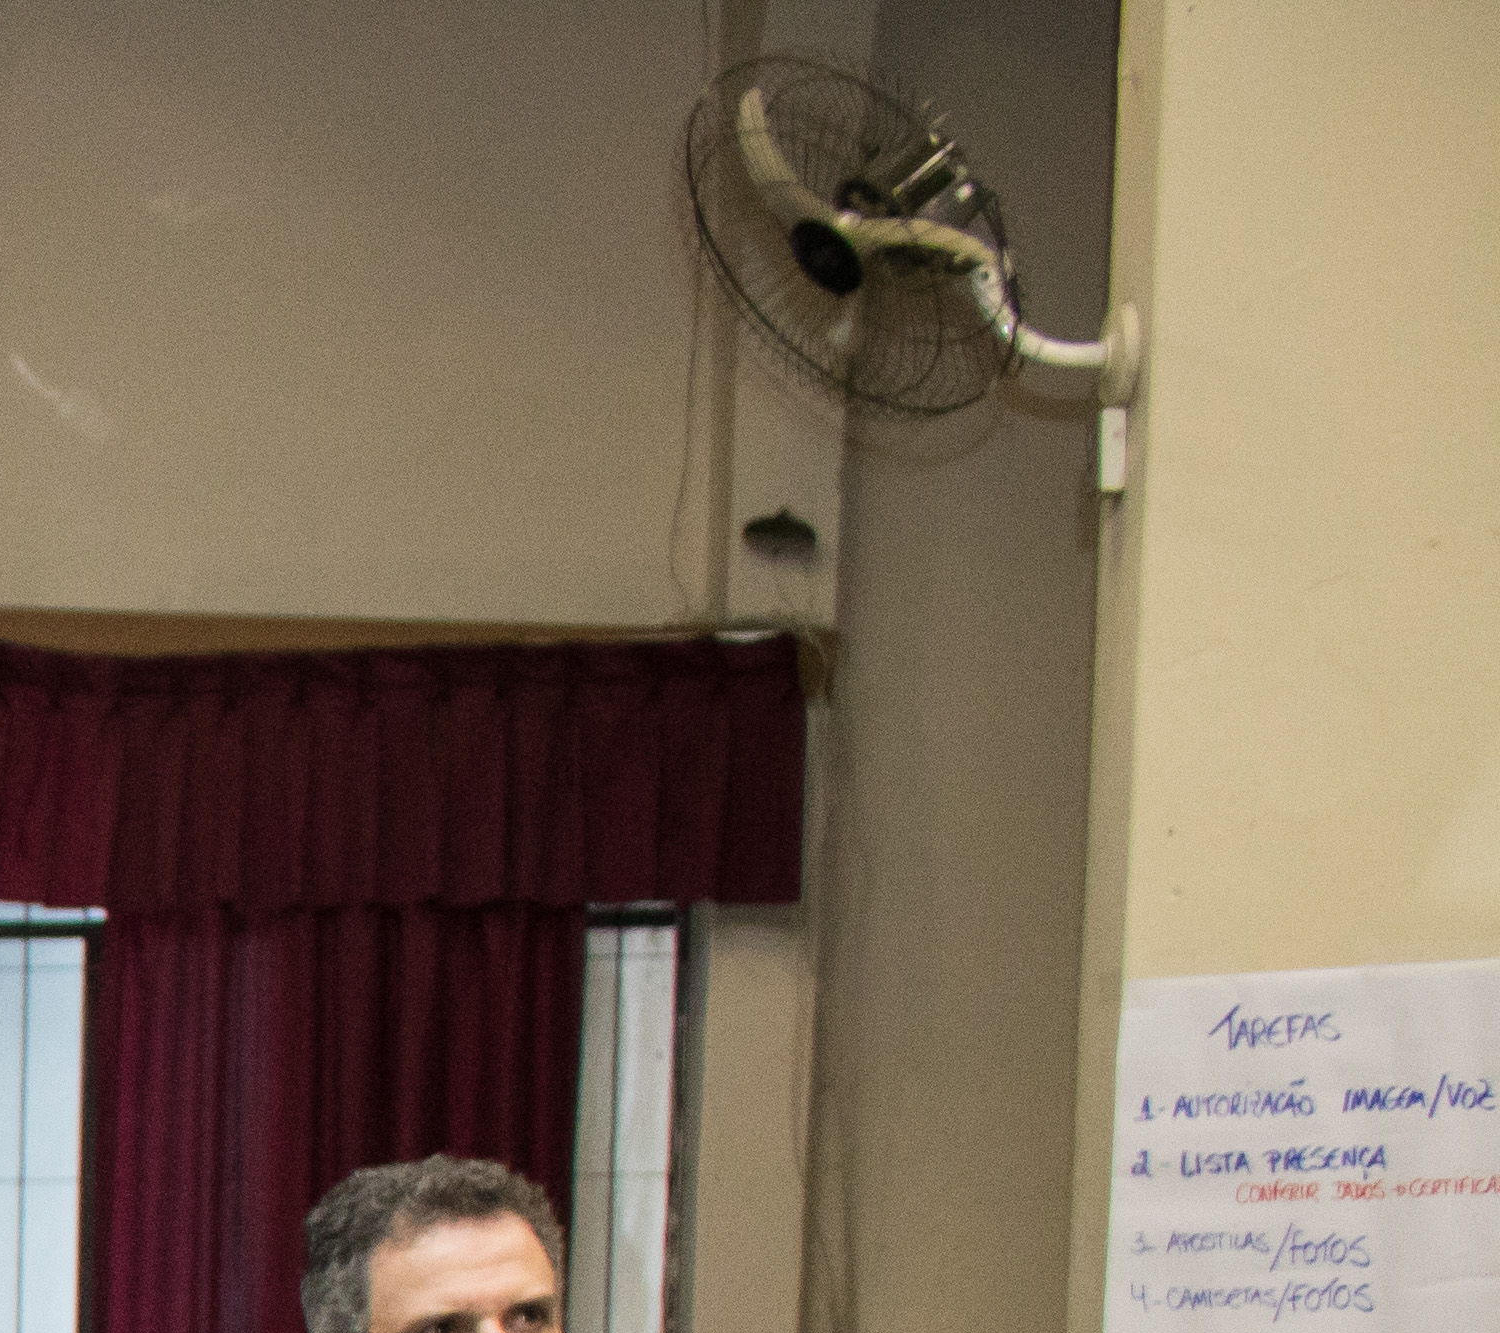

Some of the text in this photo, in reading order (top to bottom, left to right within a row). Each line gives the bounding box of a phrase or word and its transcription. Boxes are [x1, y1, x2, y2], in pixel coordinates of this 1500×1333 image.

[1208, 1004, 1342, 1050] TAREFAS
[1180, 1150, 1250, 1178] LISTA
[1263, 1145, 1388, 1181] PRESENÇA
